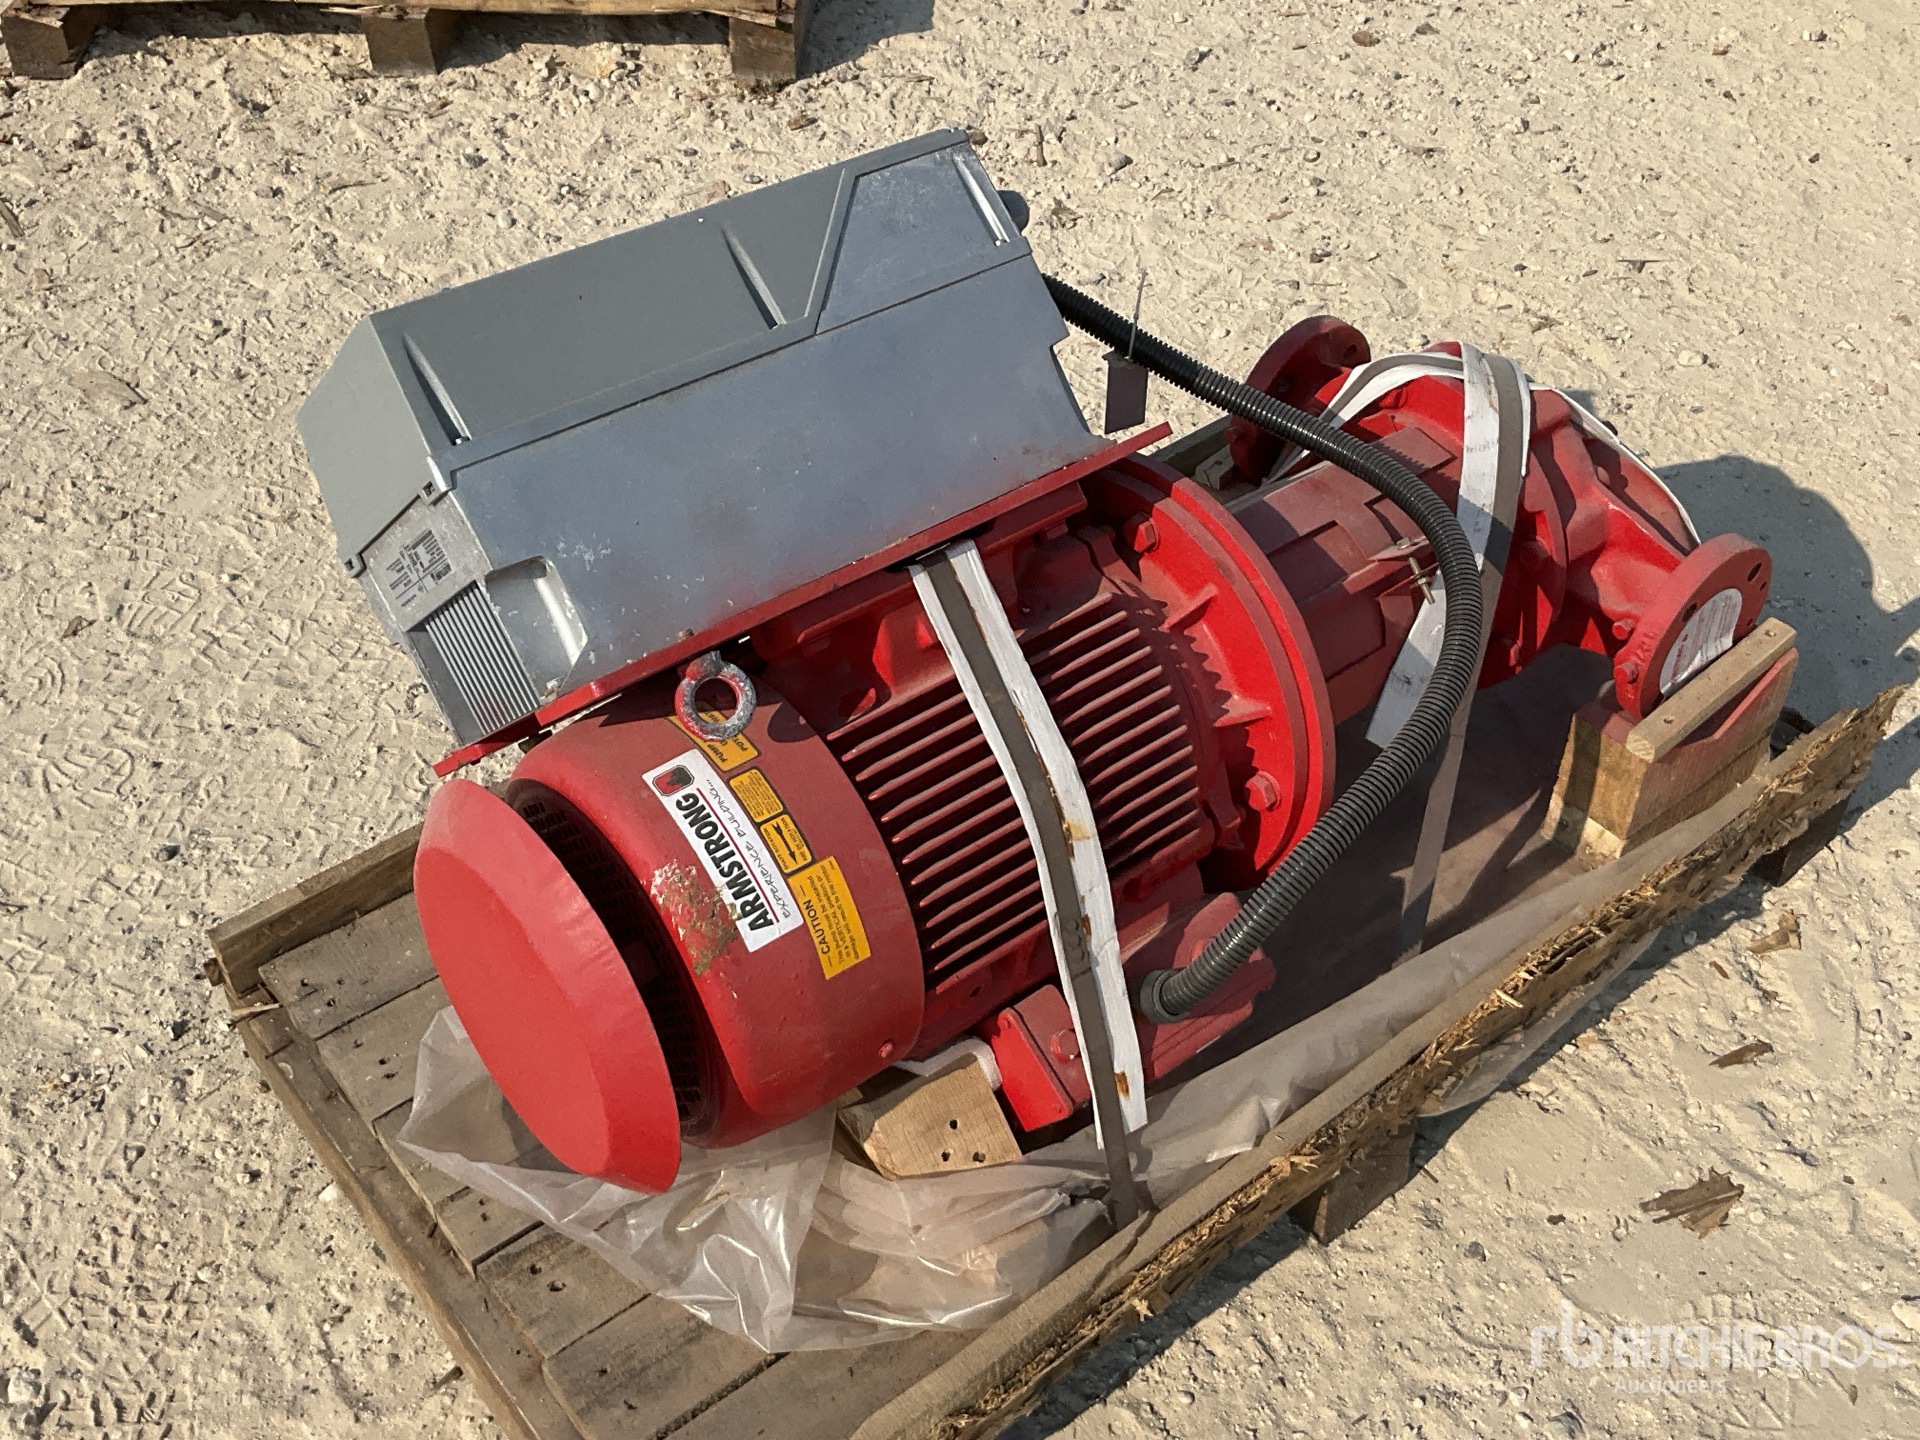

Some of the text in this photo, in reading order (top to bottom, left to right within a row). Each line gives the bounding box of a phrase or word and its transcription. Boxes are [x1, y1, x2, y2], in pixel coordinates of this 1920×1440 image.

[707, 742, 727, 762] PUMP
[675, 791, 774, 931] ARMSTRONG
[743, 839, 792, 918] EXPERIENCE
[806, 875, 822, 903] installed
[818, 882, 834, 908] position
[818, 903, 827, 913] be
[802, 899, 831, 954] CAUTION
[822, 913, 833, 930] must
[829, 909, 847, 945] VERTICAL
[829, 929, 841, 949] pump
